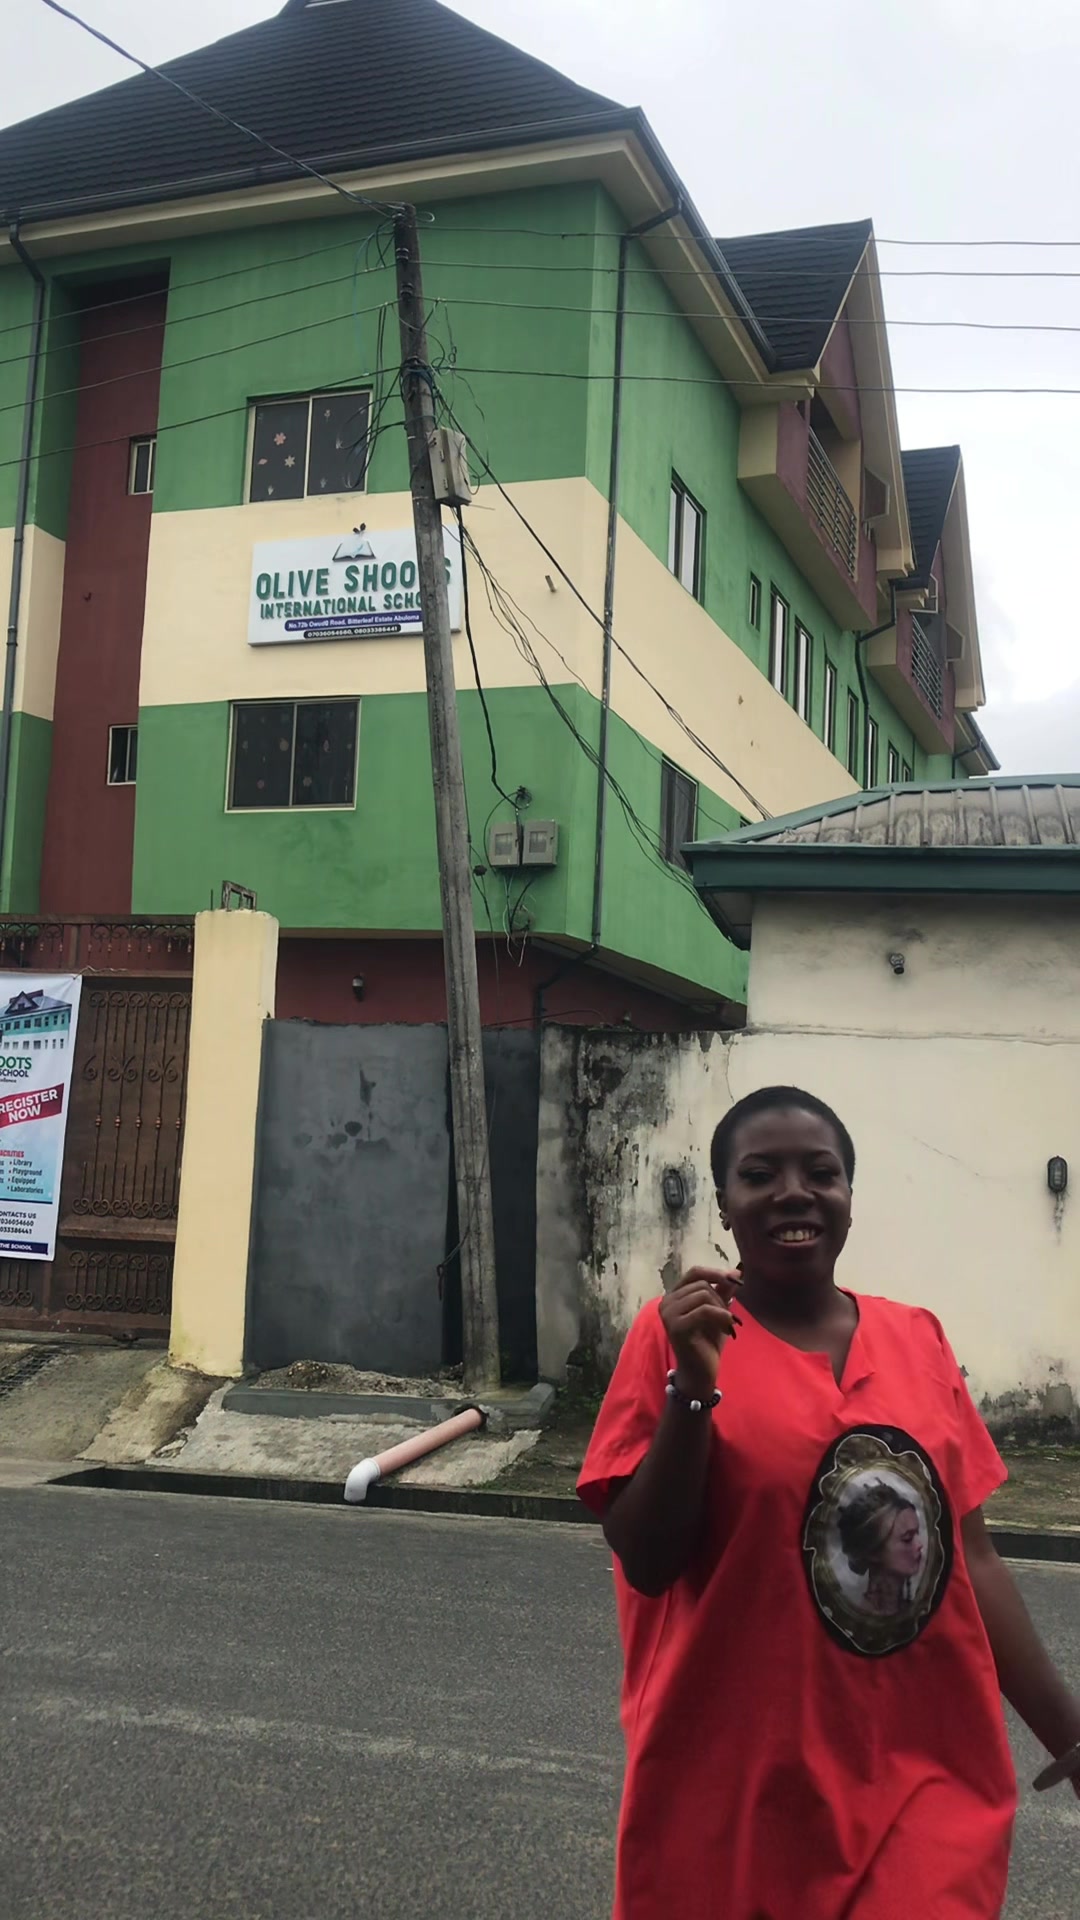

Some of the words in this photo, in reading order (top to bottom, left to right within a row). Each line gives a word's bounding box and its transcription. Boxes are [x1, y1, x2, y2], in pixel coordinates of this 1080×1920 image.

[256, 568, 329, 600] OLIVE
[344, 557, 452, 593] SHOO
[260, 596, 377, 620] INTERNATIONAL
[383, 592, 422, 610] SCHO
[347, 617, 374, 625] Bitterleaf
[394, 614, 420, 622] Abuloma
[8, 1104, 41, 1123] NOW
